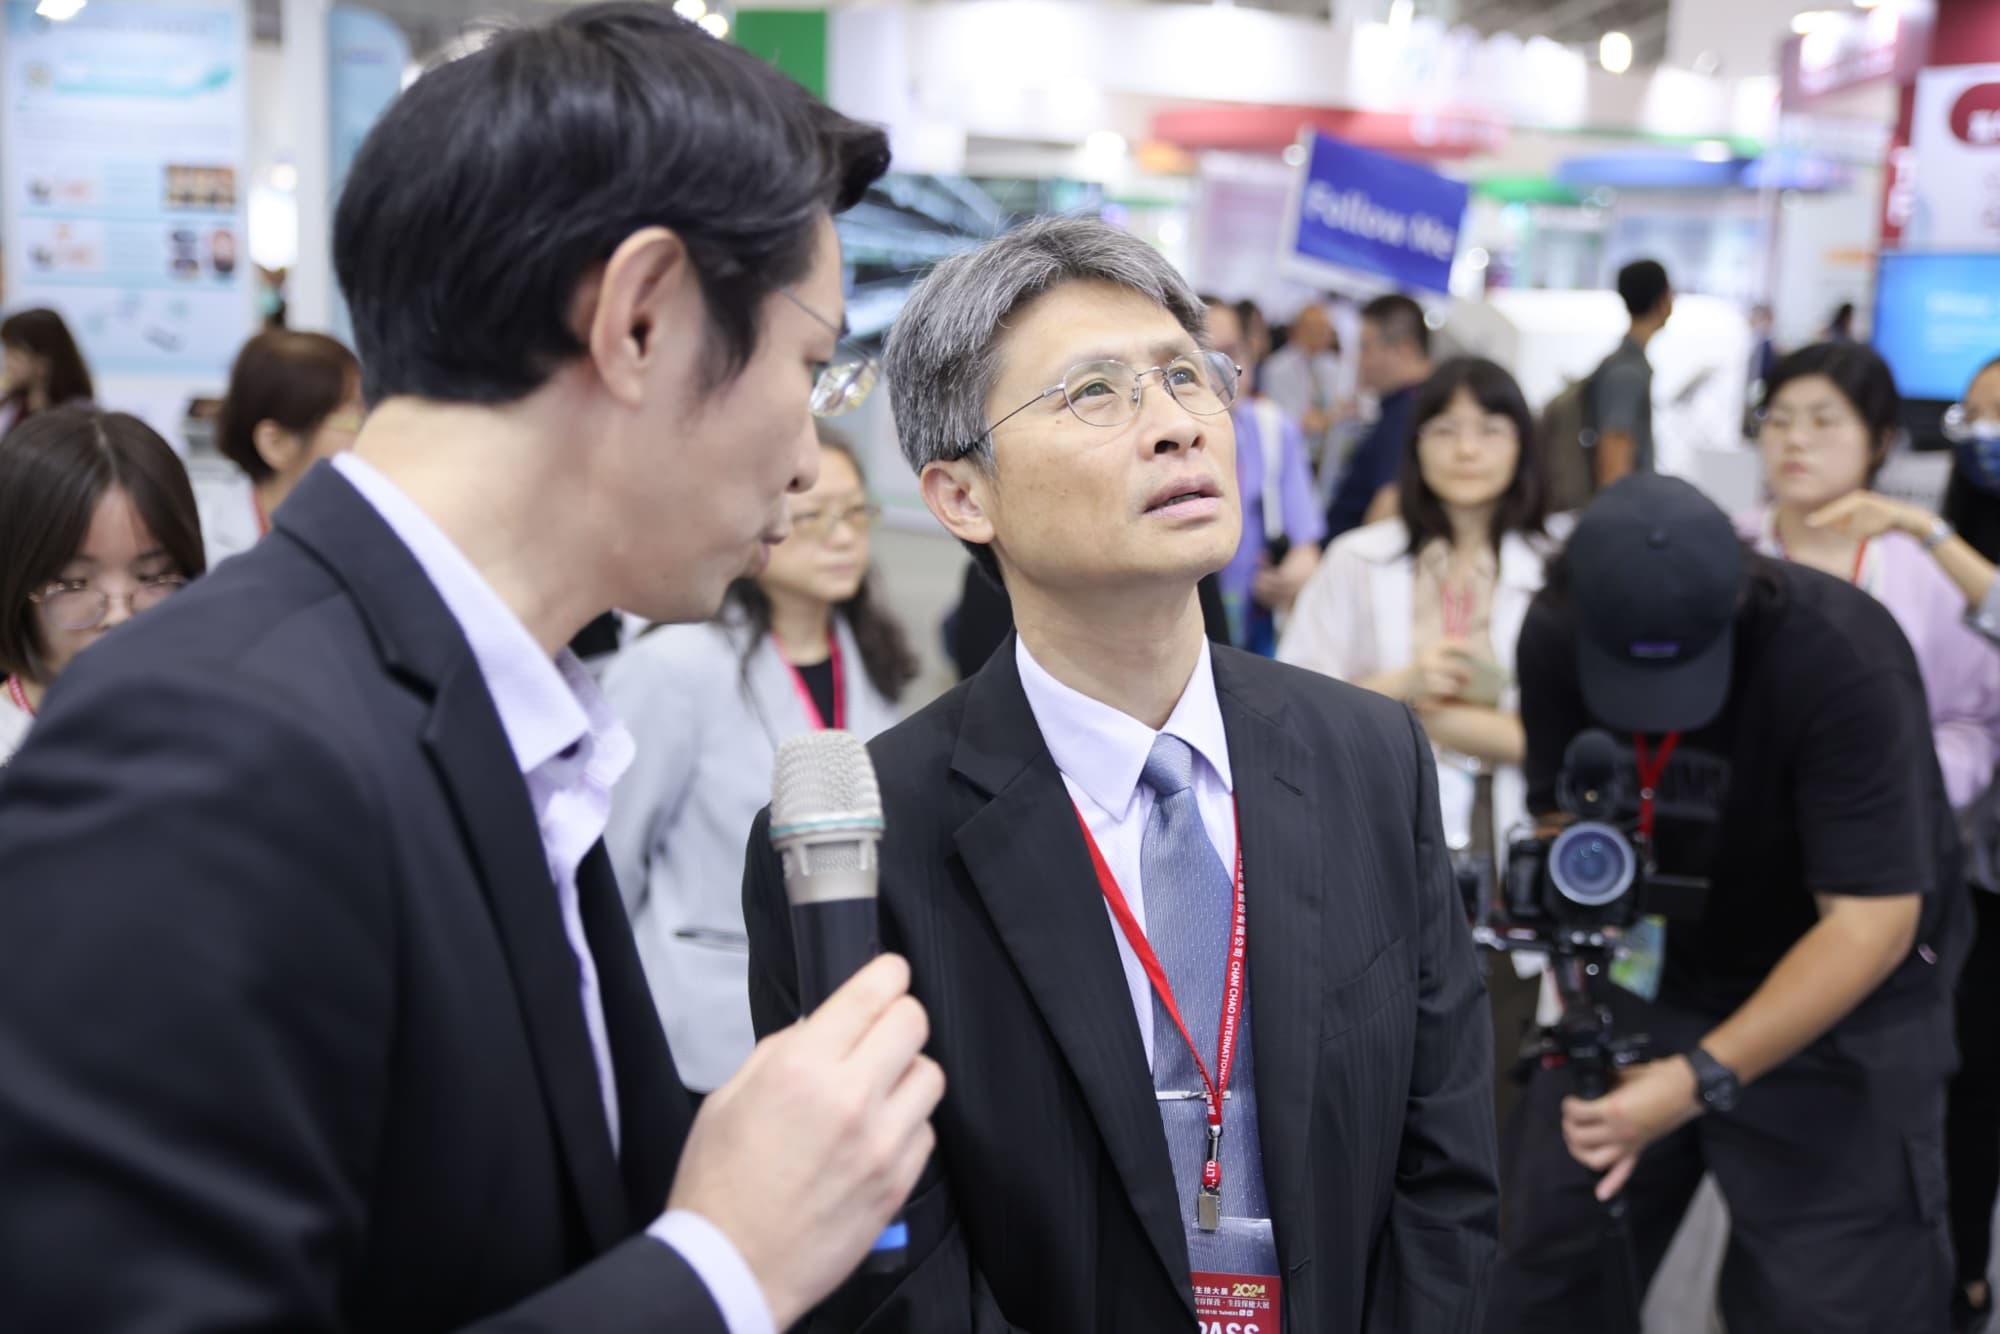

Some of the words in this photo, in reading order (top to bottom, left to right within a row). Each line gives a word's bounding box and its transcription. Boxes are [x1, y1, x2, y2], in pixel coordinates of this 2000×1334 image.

[1303, 180, 1405, 246] Follow
[1408, 211, 1455, 261] Me
[1231, 961, 1241, 986] CHAN
[1227, 988, 1238, 1014] CHAO
[1232, 1283, 1265, 1297] 2024
